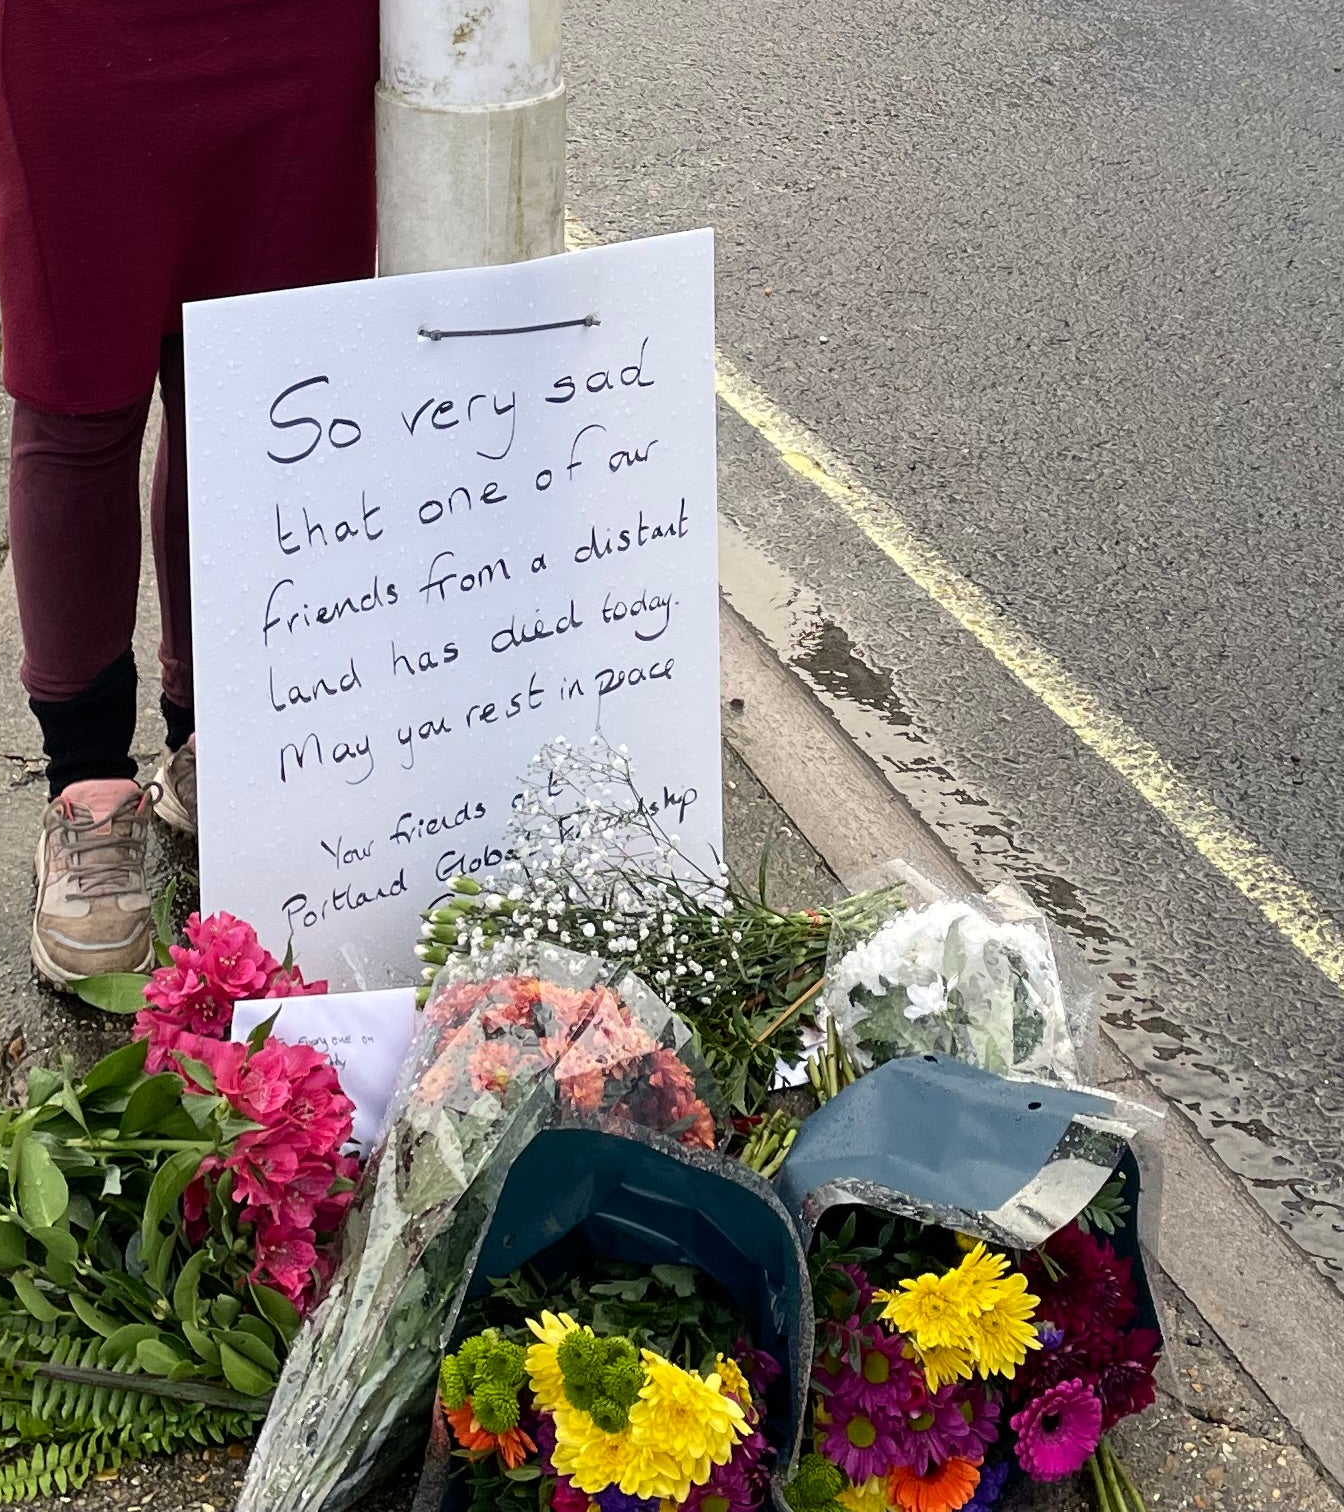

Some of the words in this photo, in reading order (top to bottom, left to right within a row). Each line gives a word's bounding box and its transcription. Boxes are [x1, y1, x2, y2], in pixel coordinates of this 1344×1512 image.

[266, 374, 362, 464] So
[401, 390, 516, 460] very
[545, 337, 655, 403] sad
[276, 490, 384, 555] that
[418, 481, 507, 525] one
[535, 424, 607, 491] of
[609, 439, 659, 473] our
[263, 578, 398, 647] friends
[419, 551, 511, 605] from
[530, 553, 547, 574] a
[574, 497, 689, 565] distant
[269, 658, 363, 712] land
[391, 639, 459, 676] has
[490, 599, 583, 654] died
[280, 732, 375, 785] May
[397, 716, 452, 769] you
[466, 672, 545, 729] rest
[559, 675, 585, 701] in
[321, 836, 374, 869] Your
[390, 803, 486, 844] friends
[281, 869, 407, 935] Portland
